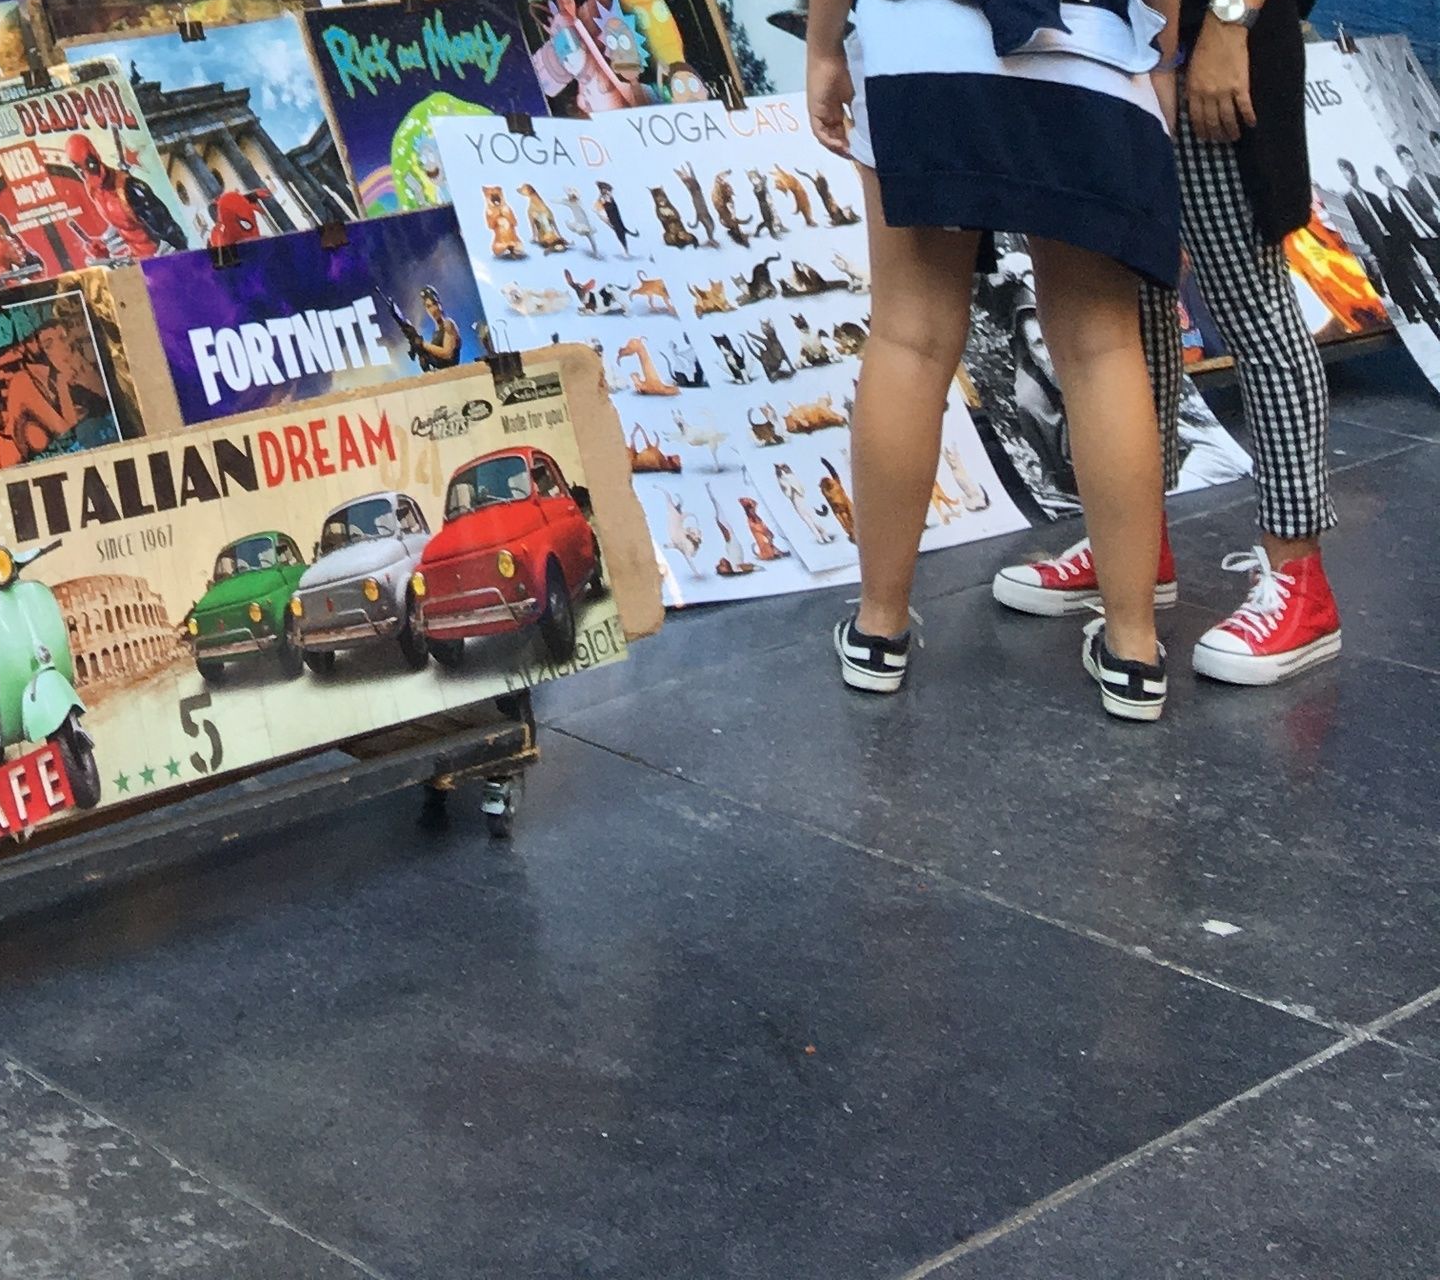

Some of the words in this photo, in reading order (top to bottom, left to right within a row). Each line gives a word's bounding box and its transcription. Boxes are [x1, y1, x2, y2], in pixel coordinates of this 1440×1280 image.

[13, 79, 141, 137] DEADPOOL
[626, 111, 727, 148] YOGA
[725, 102, 800, 137] CATS
[464, 132, 577, 168] YOGA
[188, 295, 392, 406] FORTNITE
[6, 433, 260, 545] ITALIAN
[257, 408, 398, 488] DREAM
[96, 531, 135, 564] SINCE
[139, 523, 174, 551] 1967
[179, 692, 224, 775] 5
